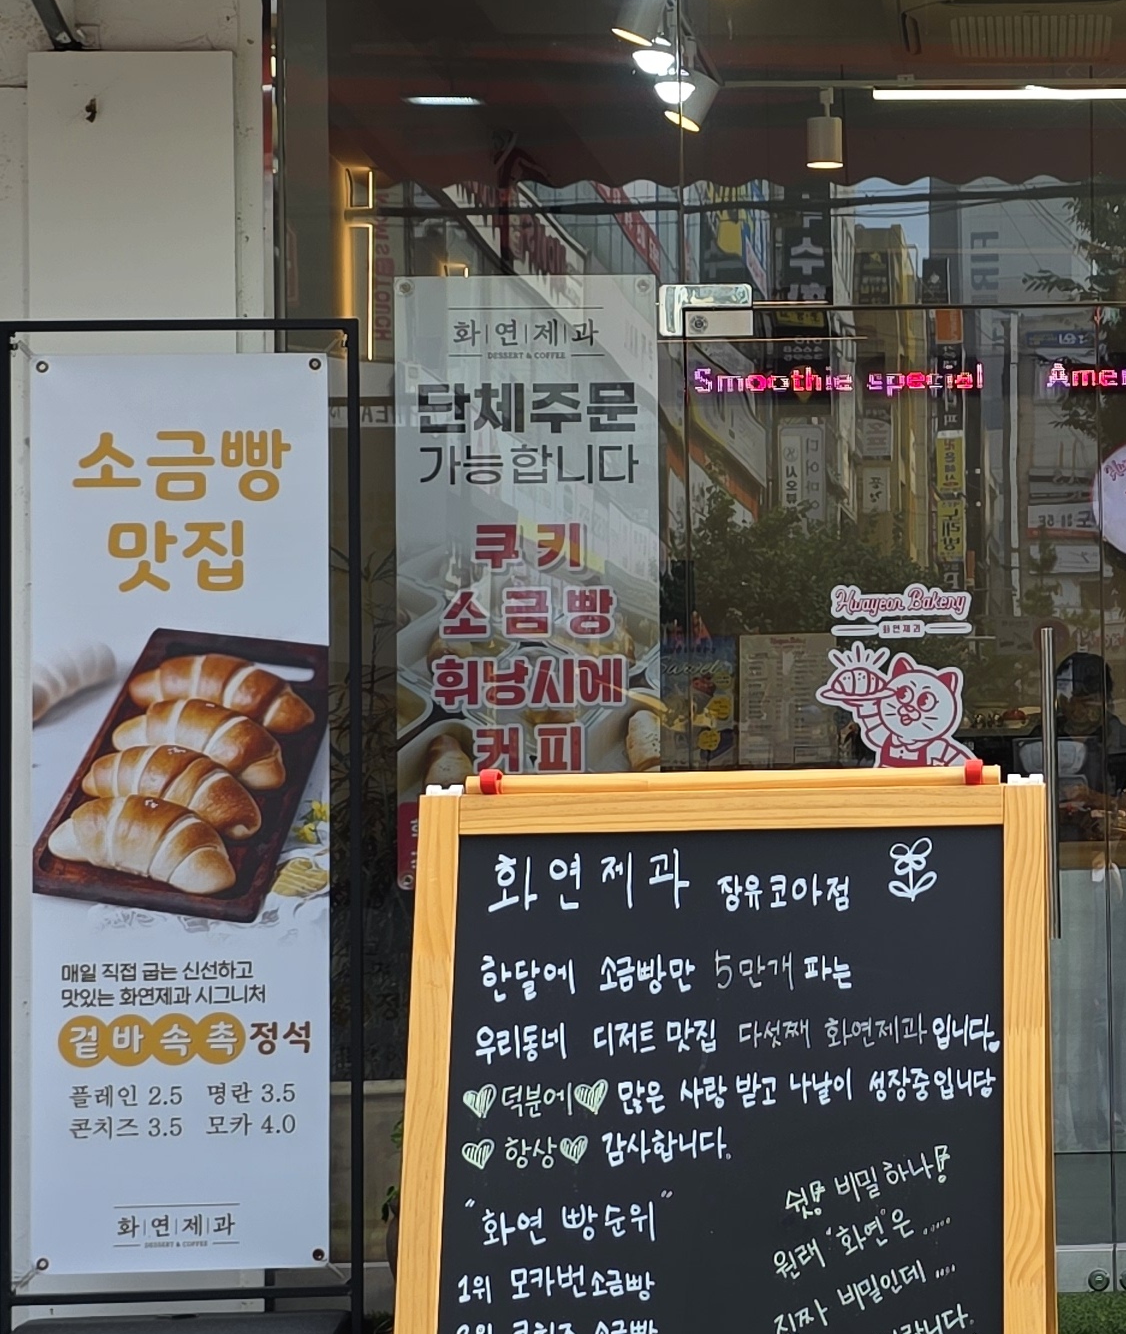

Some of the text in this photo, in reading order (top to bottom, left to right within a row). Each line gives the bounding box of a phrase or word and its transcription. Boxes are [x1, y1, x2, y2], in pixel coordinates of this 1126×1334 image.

[487, 351, 524, 360] DESSERT
[533, 351, 566, 360] COFFEE
[417, 381, 639, 434] 단체주문
[71, 427, 292, 502] 소금빵
[418, 443, 639, 485] 가능합니다
[107, 519, 245, 593] 맛집
[474, 521, 587, 569] 쿠키
[440, 586, 617, 637] 소금빵
[835, 587, 967, 617] Hwayeon Bakery
[432, 656, 626, 706] 휘낭시에
[473, 724, 586, 771] 커피
[487, 847, 850, 913] 화연제과 장유코아점
[61, 960, 254, 984] 매일 직접 굽는 신선하고
[481, 949, 853, 1002] 한달에 소금빵만 5만개 파는
[60, 984, 267, 1009] 맛있는 화연제과 시그니처
[68, 1019, 313, 1060] 겉바속촉 정석
[475, 1021, 568, 1065] 우리동네
[593, 1020, 656, 1057] 디저트
[666, 1018, 717, 1053] 맛집
[738, 1018, 811, 1049] 다섯째
[68, 1082, 297, 1108] 플레인 2.5 명란 3.5
[501, 1066, 997, 1118] 덕분에 많은 사랑 받고 나날이 성장중입니당
[68, 1113, 297, 1140] 콘치즈 3.5 모카 4.0
[504, 1136, 558, 1169] 항상
[833, 1165, 882, 1204] 비밀
[772, 1237, 826, 1280] 원래
[456, 1273, 493, 1304] 1위
